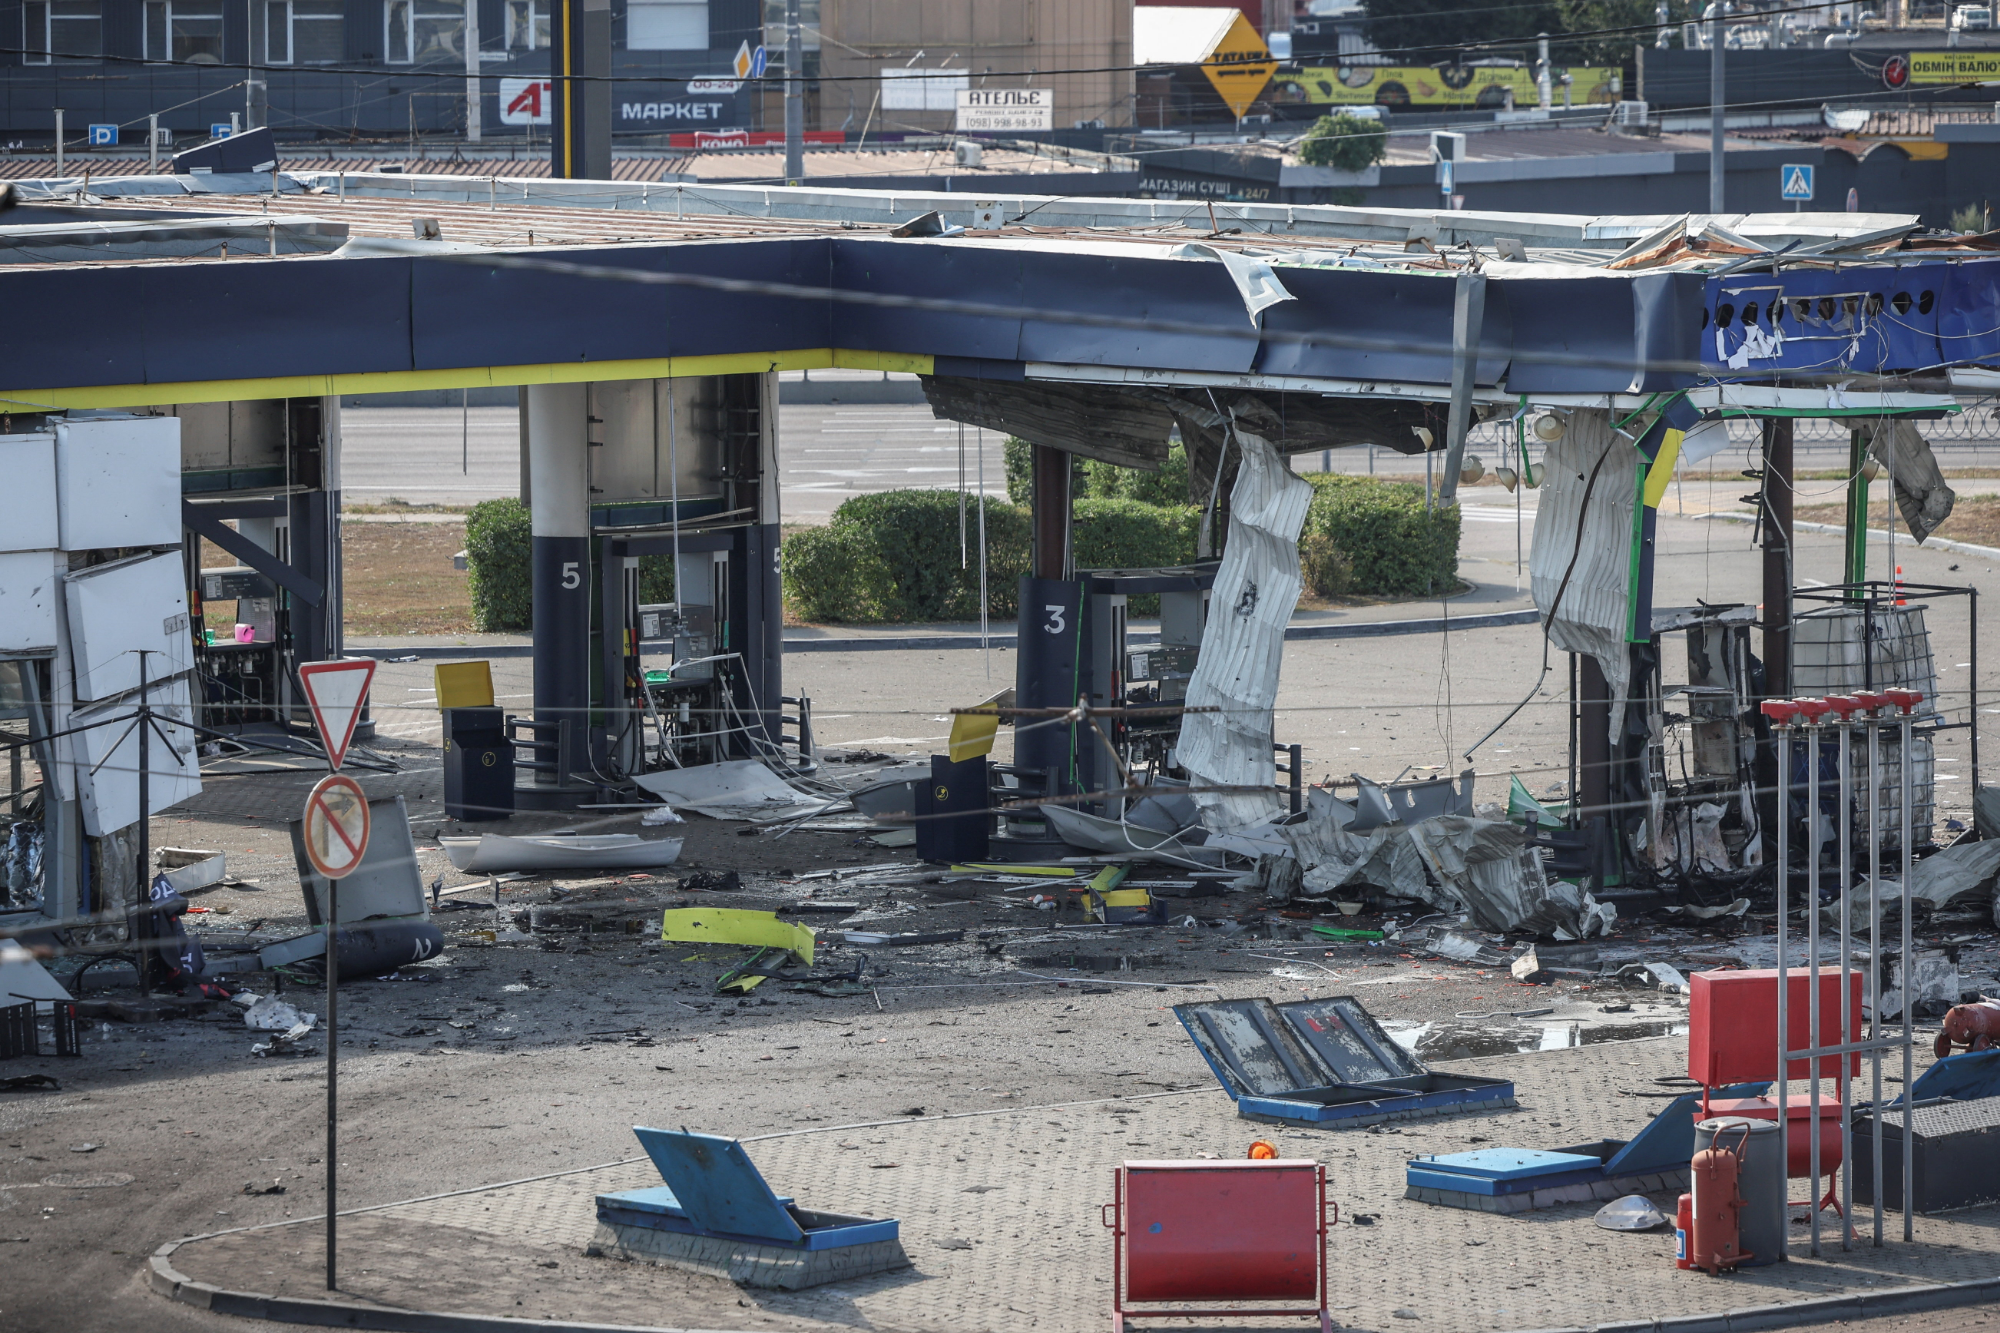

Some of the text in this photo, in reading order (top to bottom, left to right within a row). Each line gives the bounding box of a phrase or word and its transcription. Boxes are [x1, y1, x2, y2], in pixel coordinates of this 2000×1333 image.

[1913, 61, 2000, 72] ОБМІН ВАЛЮ
[622, 102, 723, 119] МАРКЕТ
[966, 117, 1043, 128] (098) 998-98-93
[96, 128, 111, 145] P
[1139, 178, 1270, 200] МАГАЗИН СУШІ 24/7
[561, 562, 580, 590] 5
[1044, 605, 1065, 634] 3
[411, 937, 432, 960] 2
